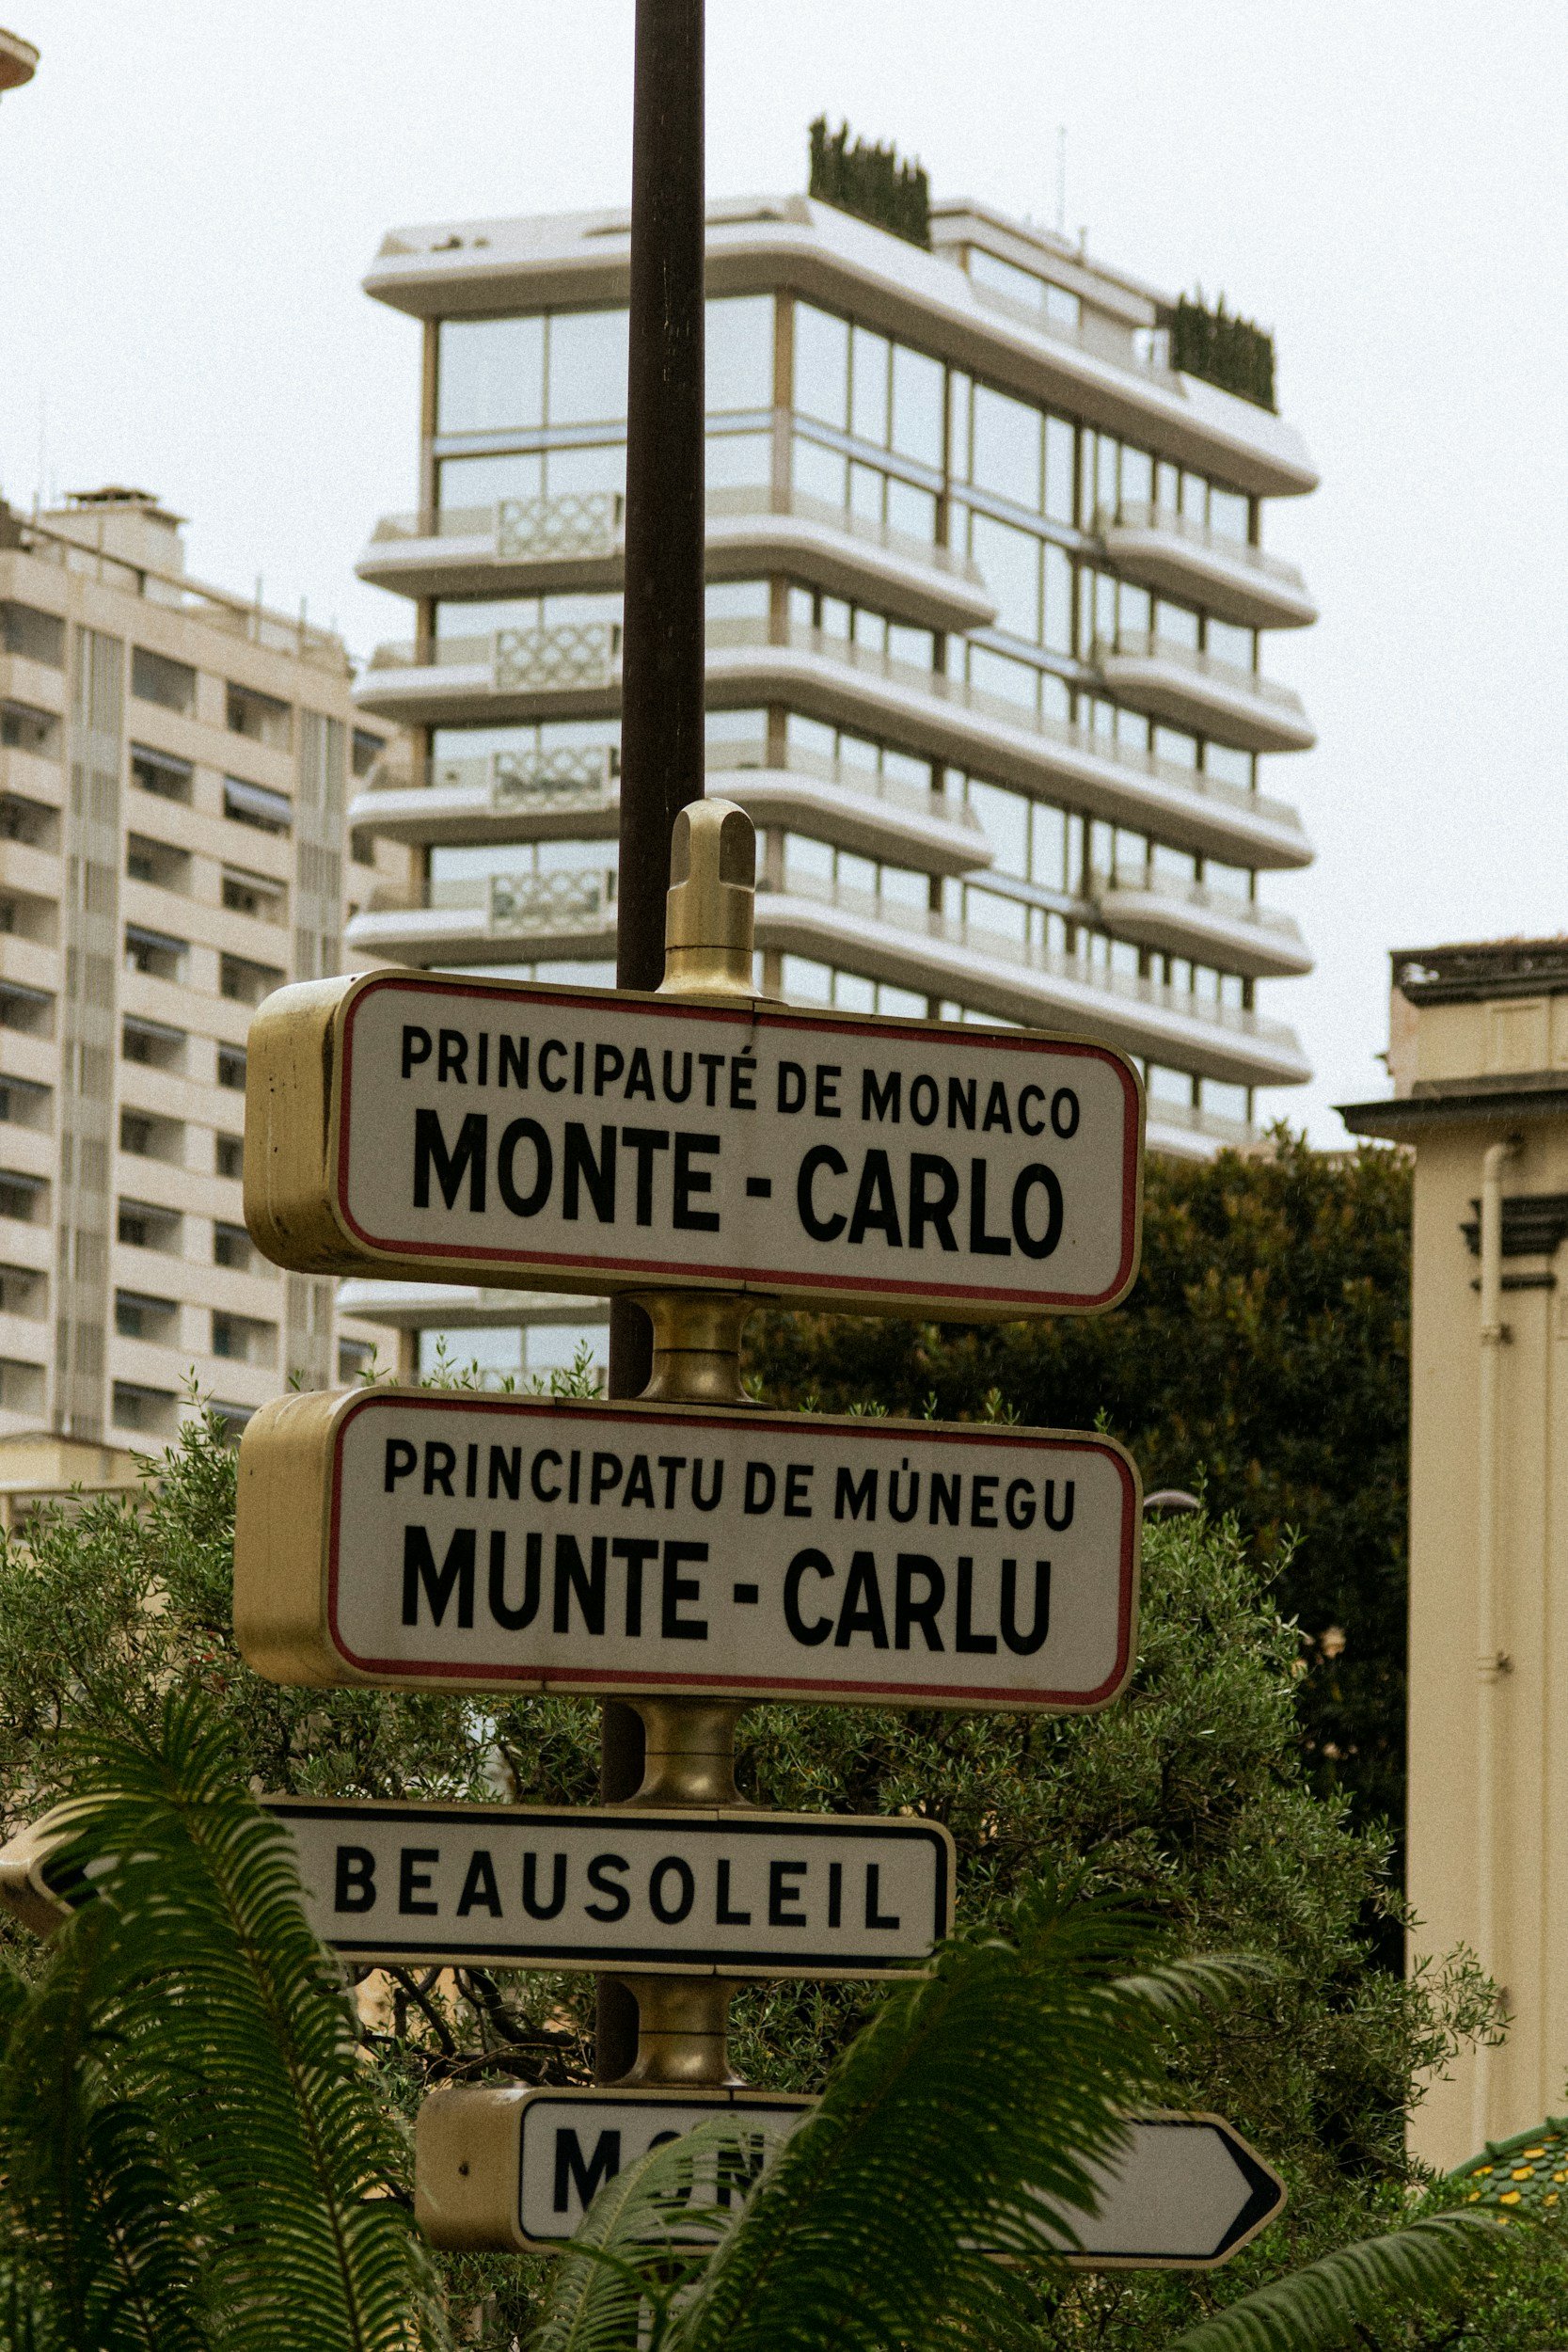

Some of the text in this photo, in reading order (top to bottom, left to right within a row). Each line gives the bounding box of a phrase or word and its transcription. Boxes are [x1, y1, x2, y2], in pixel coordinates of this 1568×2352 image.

[400, 1024, 1082, 1141] PRINCIPAUTÉ DE MONACO
[412, 1107, 721, 1233] MONTE
[795, 1143, 1065, 1261] CARLO
[383, 1437, 1076, 1532] PRINCIPATU DE MÚNEGU
[400, 1523, 710, 1642] MUNTE
[782, 1547, 1053, 1658] CARLU
[333, 1844, 901, 1931] BEAUSOLEIL
